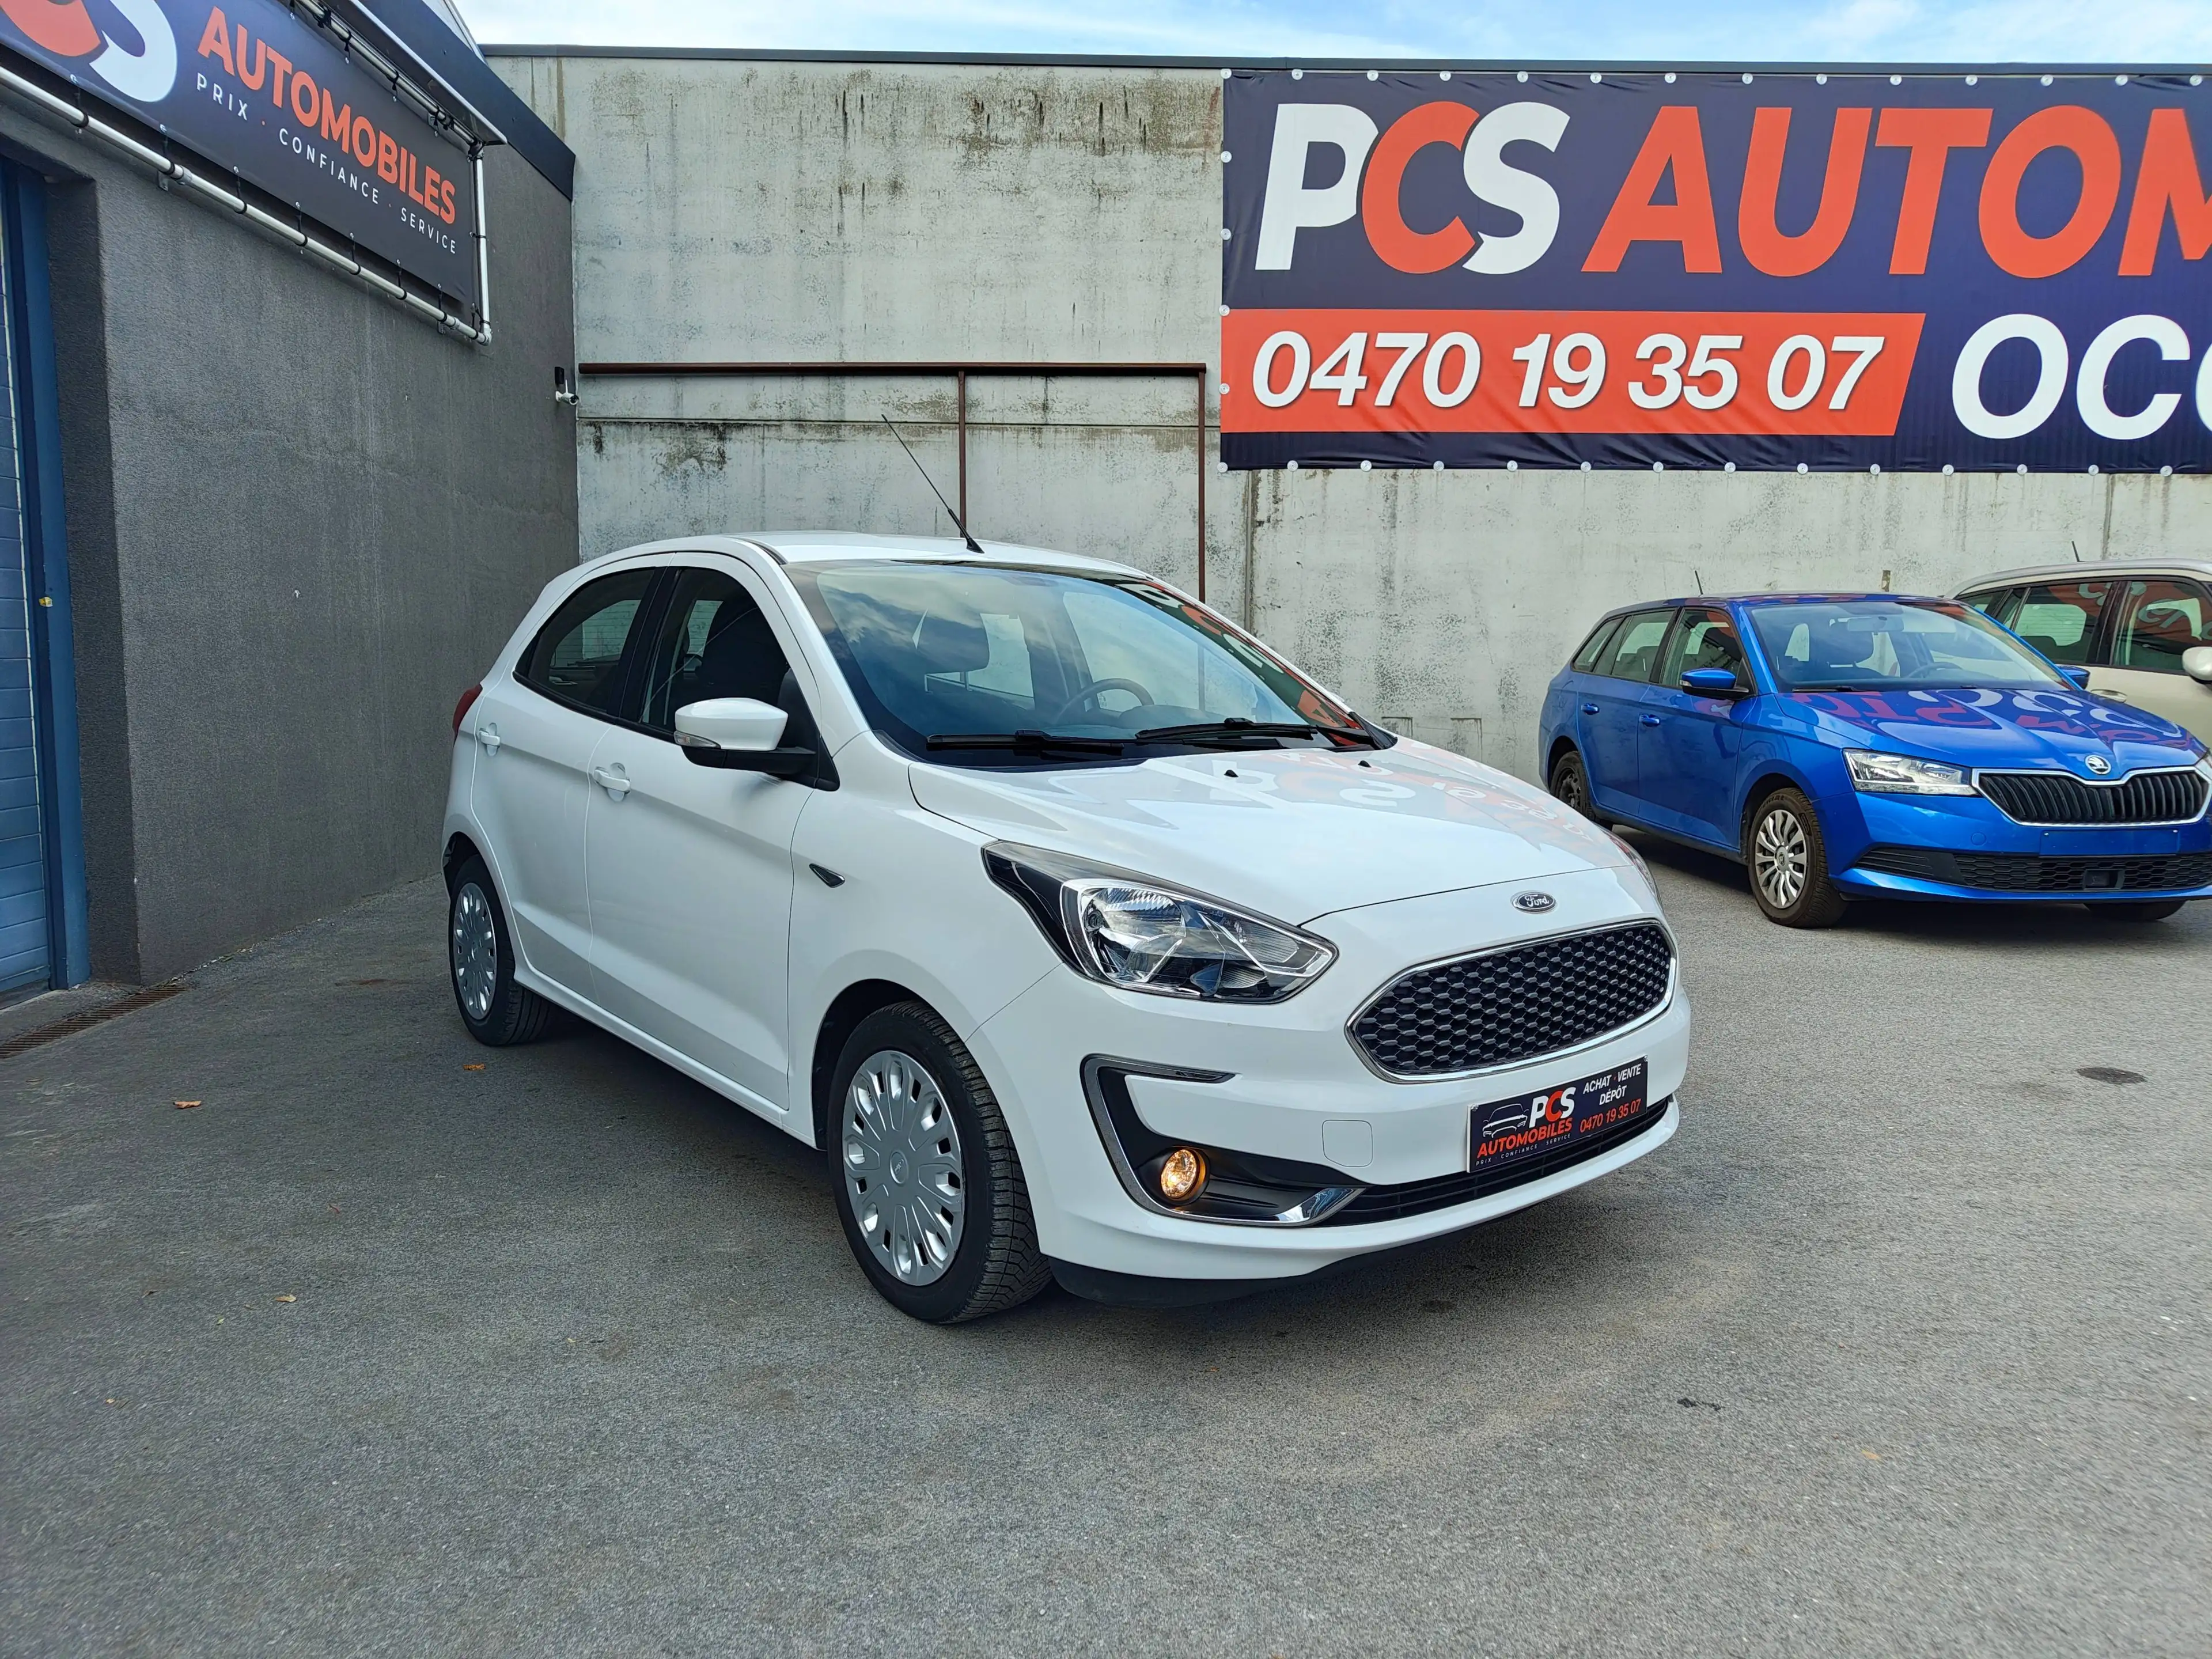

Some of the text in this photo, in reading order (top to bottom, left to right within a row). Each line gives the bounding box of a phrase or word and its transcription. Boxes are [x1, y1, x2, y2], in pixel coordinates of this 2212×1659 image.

[198, 6, 456, 225] AUTOMOBILES
[196, 73, 456, 254] PRIX CONFIANCE SERVICE
[1255, 101, 1570, 275] PCS
[1252, 331, 1885, 411] 0470 19 35 07
[1952, 313, 2212, 440] OC
[1524, 894, 1550, 907] Ford
[1582, 1063, 1642, 1094] ACHAT VENTE
[1599, 1085, 1627, 1105] DÉPÔT
[1529, 1087, 1576, 1128] PCS
[1580, 1098, 1642, 1133] 0470 19 35 07
[1476, 1133, 1571, 1166] PRIX CONFIANCE SERVICE
[1477, 1118, 1573, 1158] AUTOMOBILES
